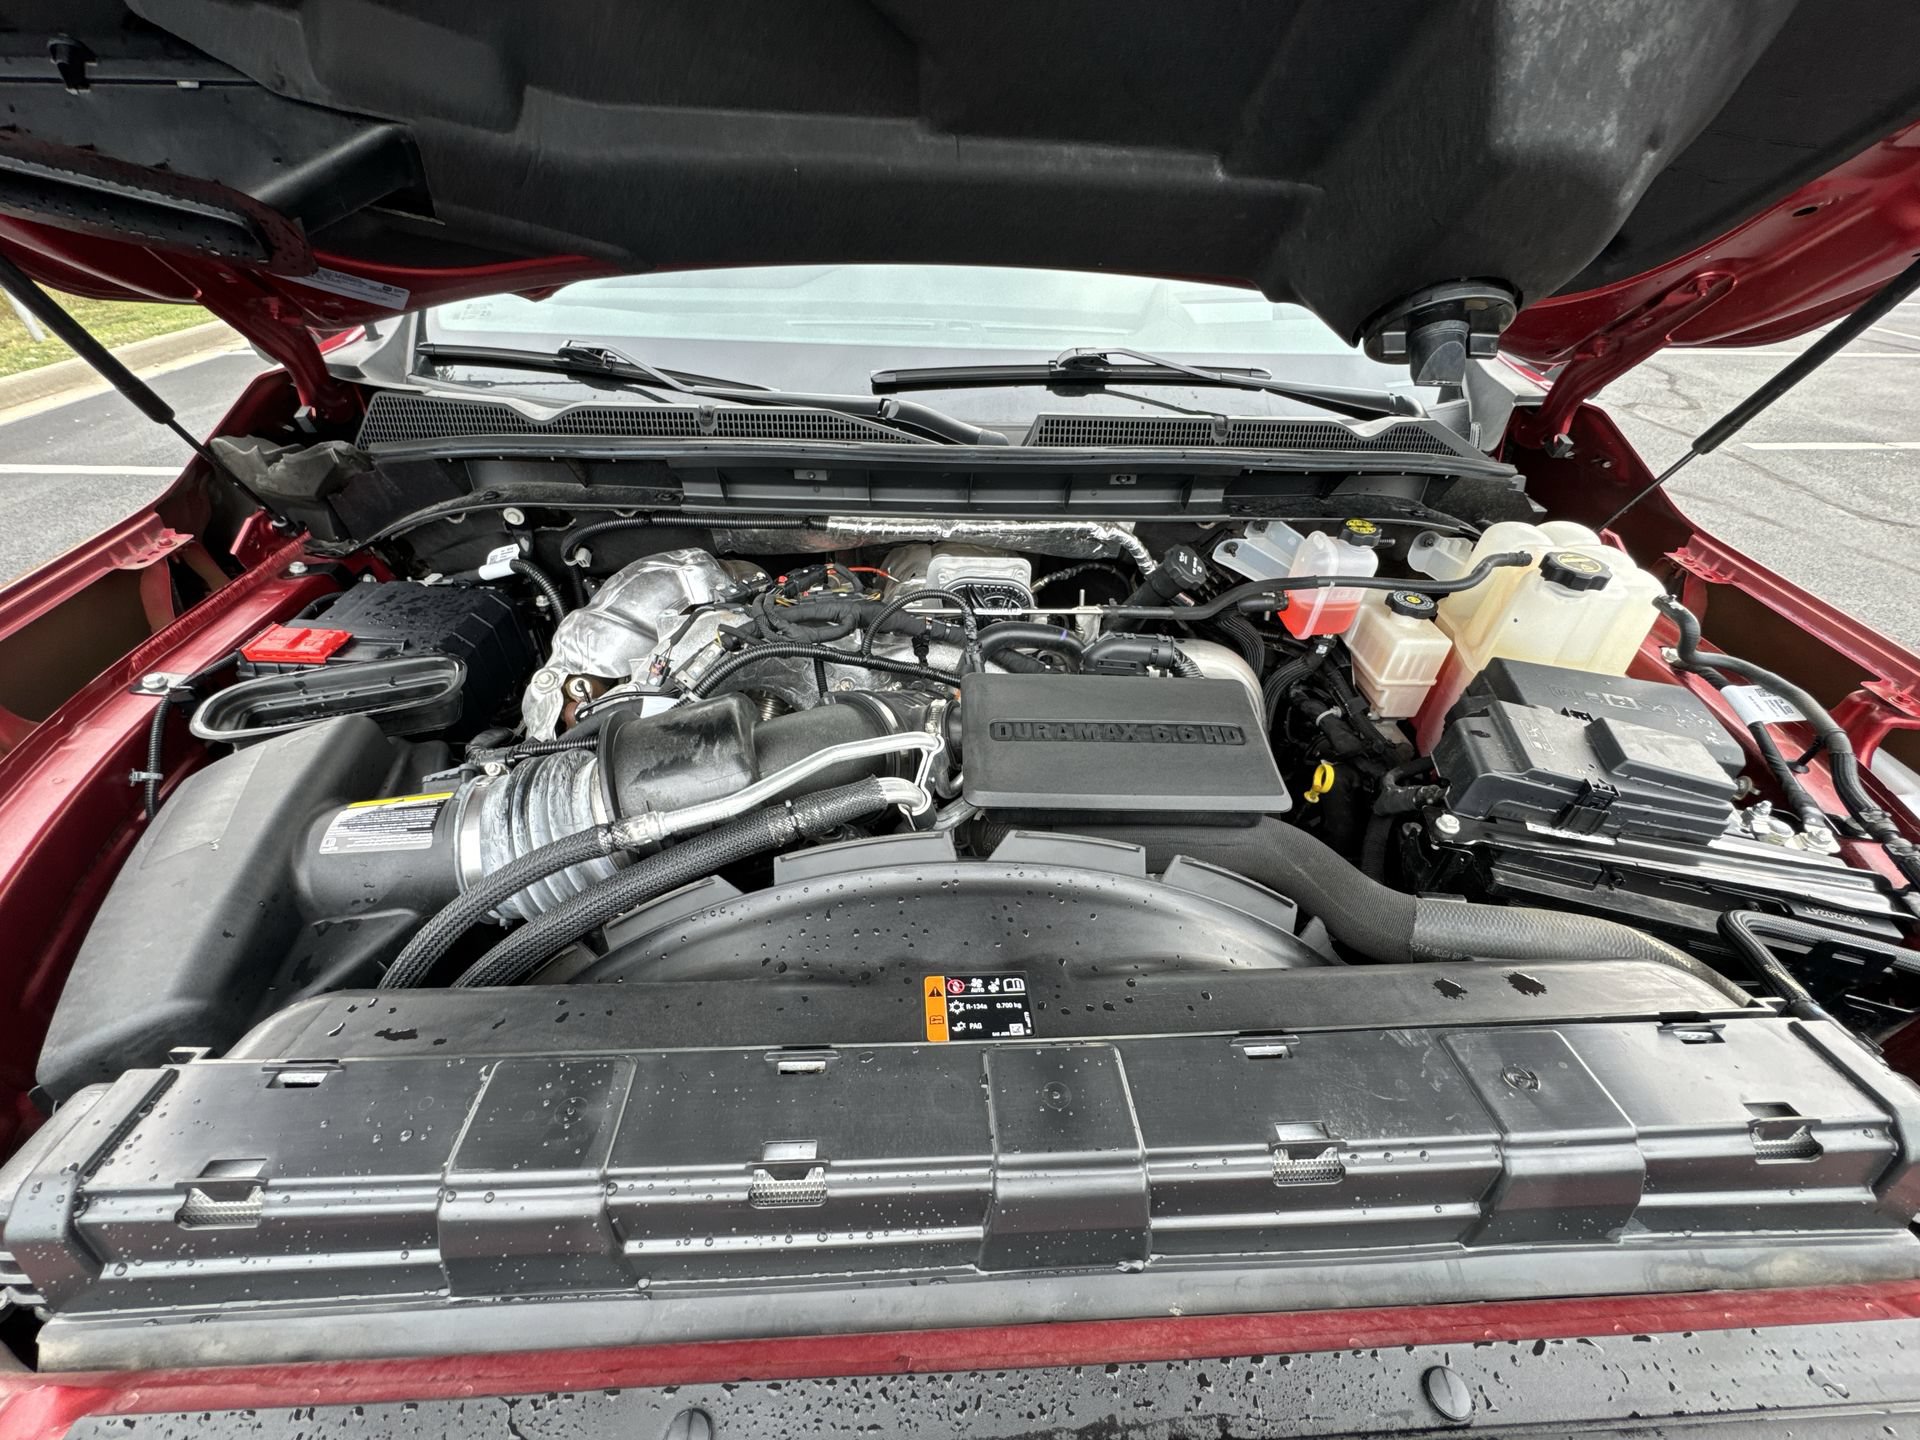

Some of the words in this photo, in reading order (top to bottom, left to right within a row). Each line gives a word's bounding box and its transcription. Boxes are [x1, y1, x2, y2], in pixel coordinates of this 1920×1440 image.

[994, 722, 1140, 742] DURAMAX
[1150, 724, 1198, 744] 6.6
[1200, 725, 1244, 745] HD
[969, 1022, 983, 1030] PAG
